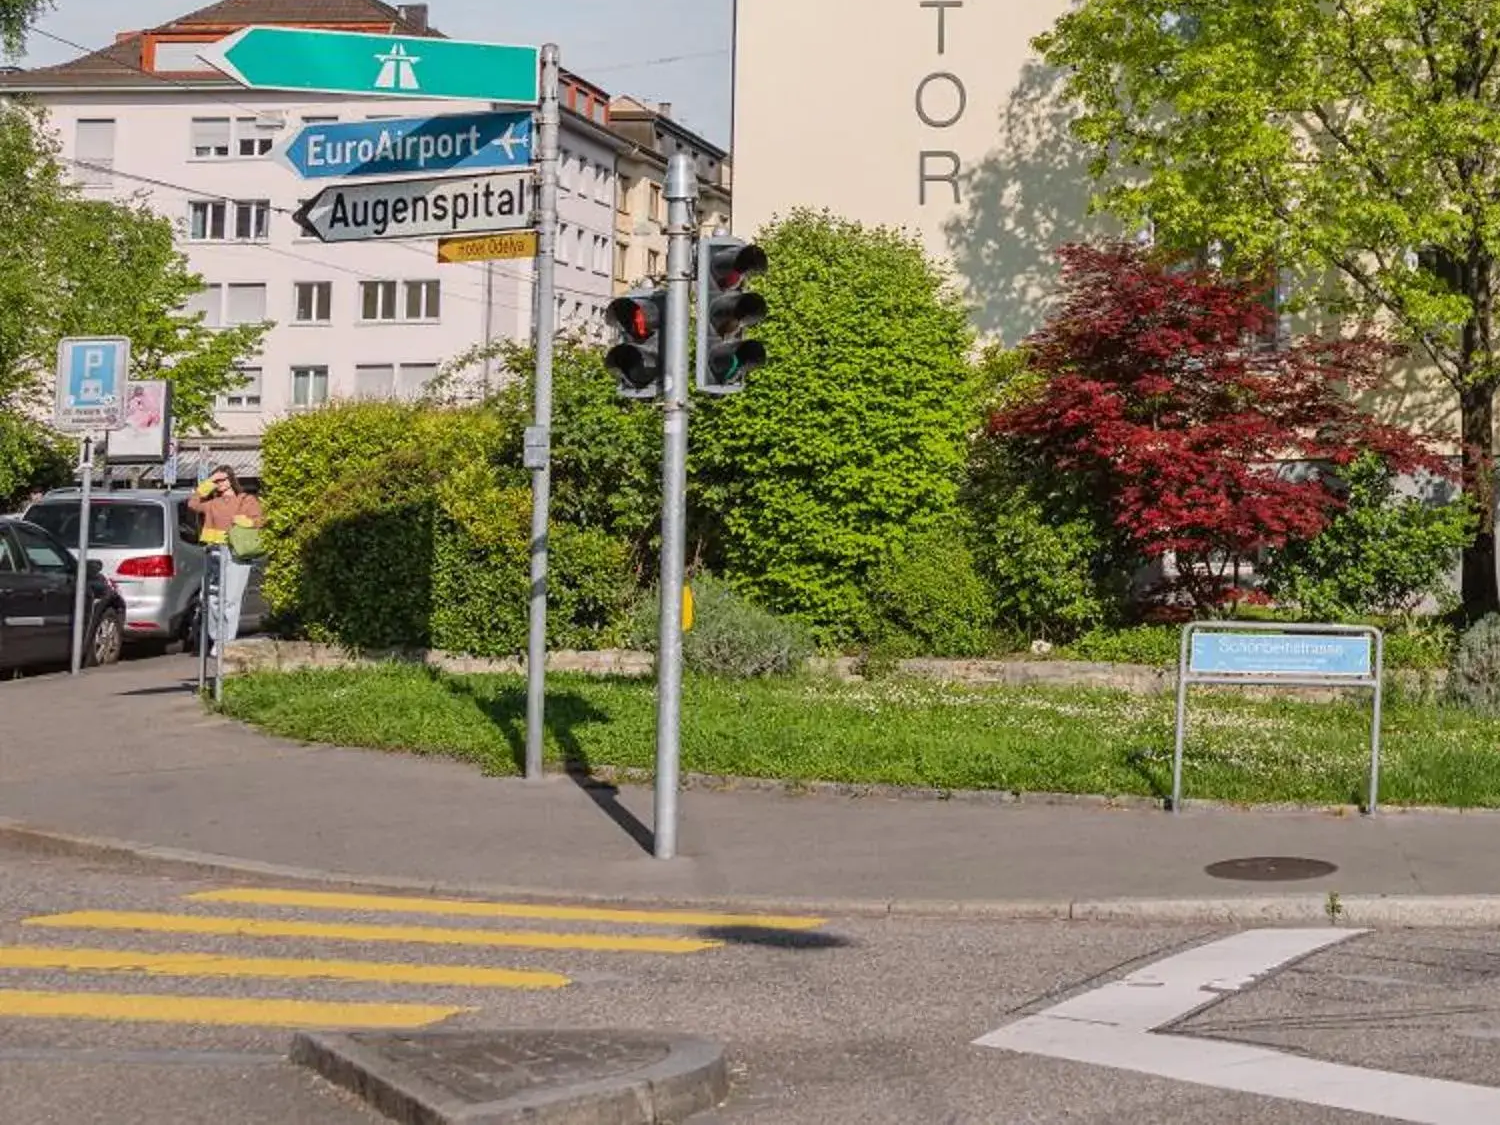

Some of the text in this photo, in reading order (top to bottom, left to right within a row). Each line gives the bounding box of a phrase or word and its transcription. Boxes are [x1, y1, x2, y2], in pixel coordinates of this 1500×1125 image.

[306, 125, 482, 167] EuroAirport
[328, 178, 525, 235] Augenspital
[84, 348, 104, 378] P
